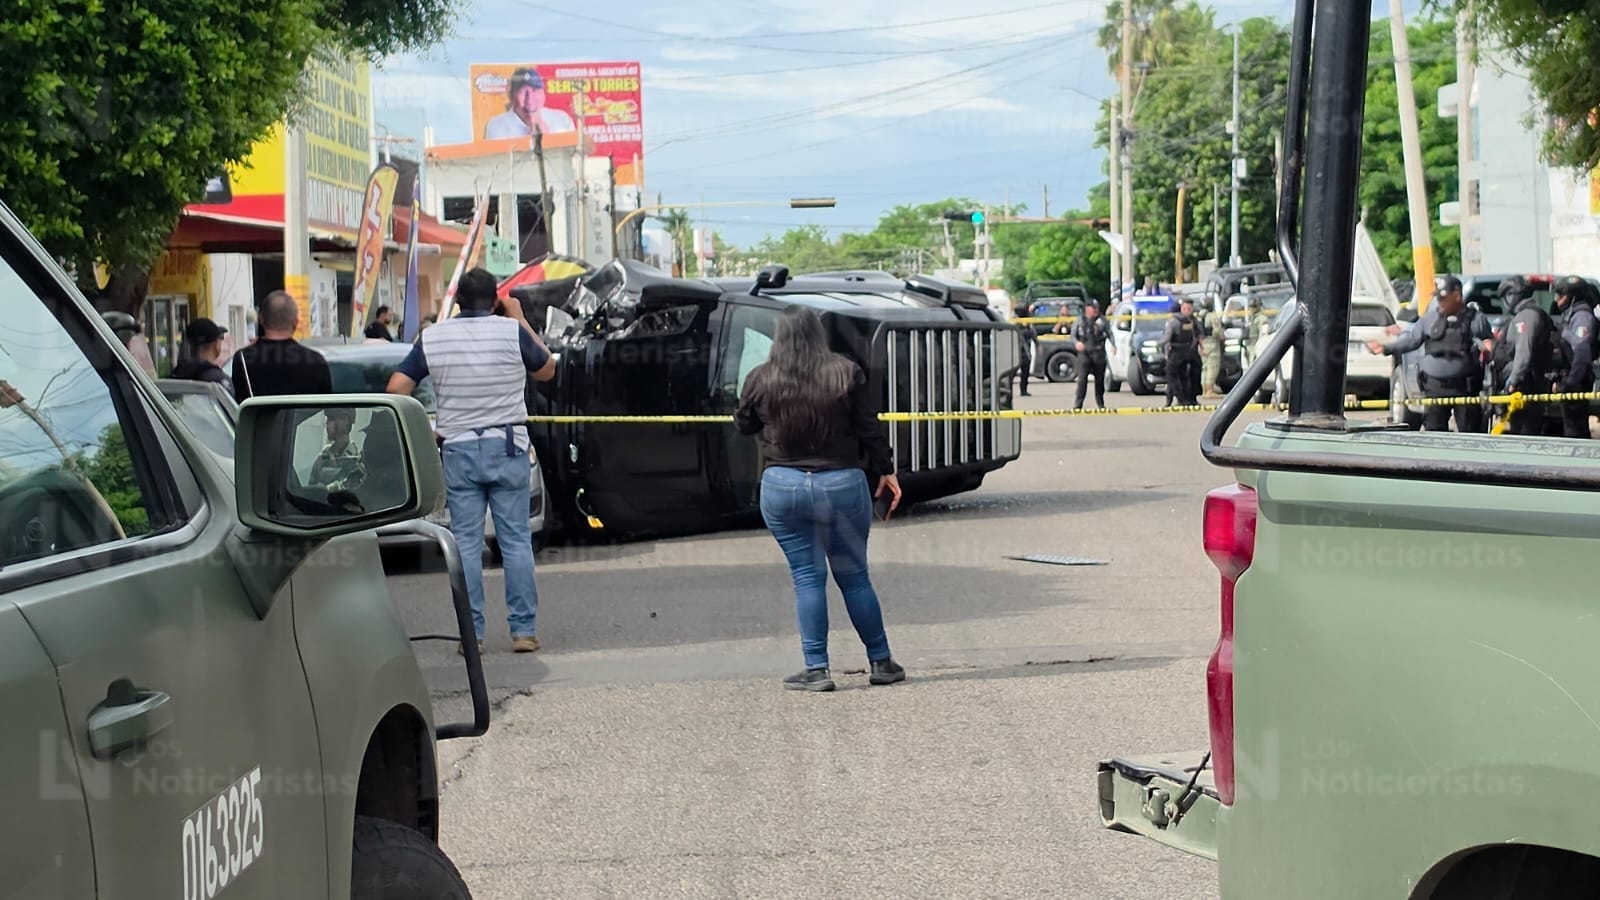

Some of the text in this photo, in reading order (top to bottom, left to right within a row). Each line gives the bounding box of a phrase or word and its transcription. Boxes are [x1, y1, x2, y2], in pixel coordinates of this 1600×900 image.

[547, 77, 639, 94] SERO TORRES
[182, 766, 263, 900] 0163325
